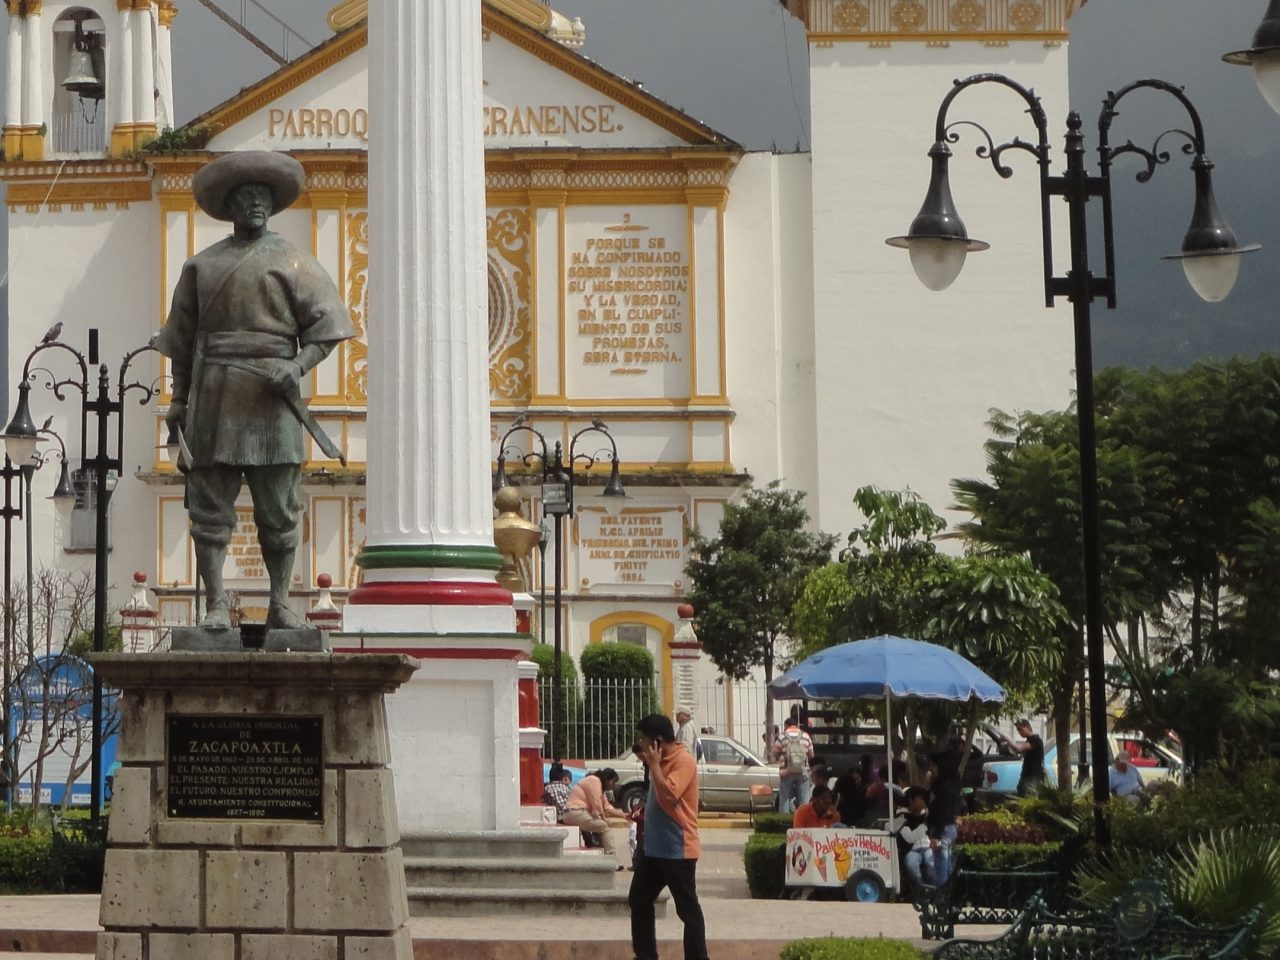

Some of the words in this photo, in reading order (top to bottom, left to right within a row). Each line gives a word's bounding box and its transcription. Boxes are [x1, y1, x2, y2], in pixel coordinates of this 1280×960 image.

[586, 238, 640, 251] PORQUE
[648, 237, 665, 249] SE
[572, 252, 589, 263] HA
[596, 251, 681, 263] CONFIRMADO
[568, 266, 611, 278] SOBRE
[618, 265, 689, 277] NOSOTROS
[569, 281, 586, 292] SU
[584, 294, 593, 306] Y
[599, 294, 617, 306] LA
[623, 294, 680, 306] VERDAD,
[578, 309, 596, 320] EN
[603, 309, 620, 320] EL
[627, 308, 680, 320] CUMPLI-
[579, 322, 627, 334] MIENTO
[631, 322, 649, 333] DE
[655, 322, 681, 333] SUS
[593, 337, 669, 349] PROMESAS,
[623, 351, 682, 363] ETERNA.
[239, 730, 251, 739] DE
[189, 741, 303, 754] ZACAPOAXTLA
[177, 765, 188, 774] EL
[231, 765, 270, 775] NUESTRO
[272, 766, 314, 775] EJEMPLO
[170, 775, 181, 784] EL
[232, 776, 273, 785] NUESTRA
[275, 777, 320, 786] REALIDAD
[170, 787, 181, 795] EL
[220, 787, 261, 796] NUESTRO
[262, 787, 320, 797] COMPROMISO
[188, 798, 246, 806] AYUNTAMIENTO
[248, 799, 312, 808] CONSTITUCIONAL
[859, 835, 891, 860] Helados
